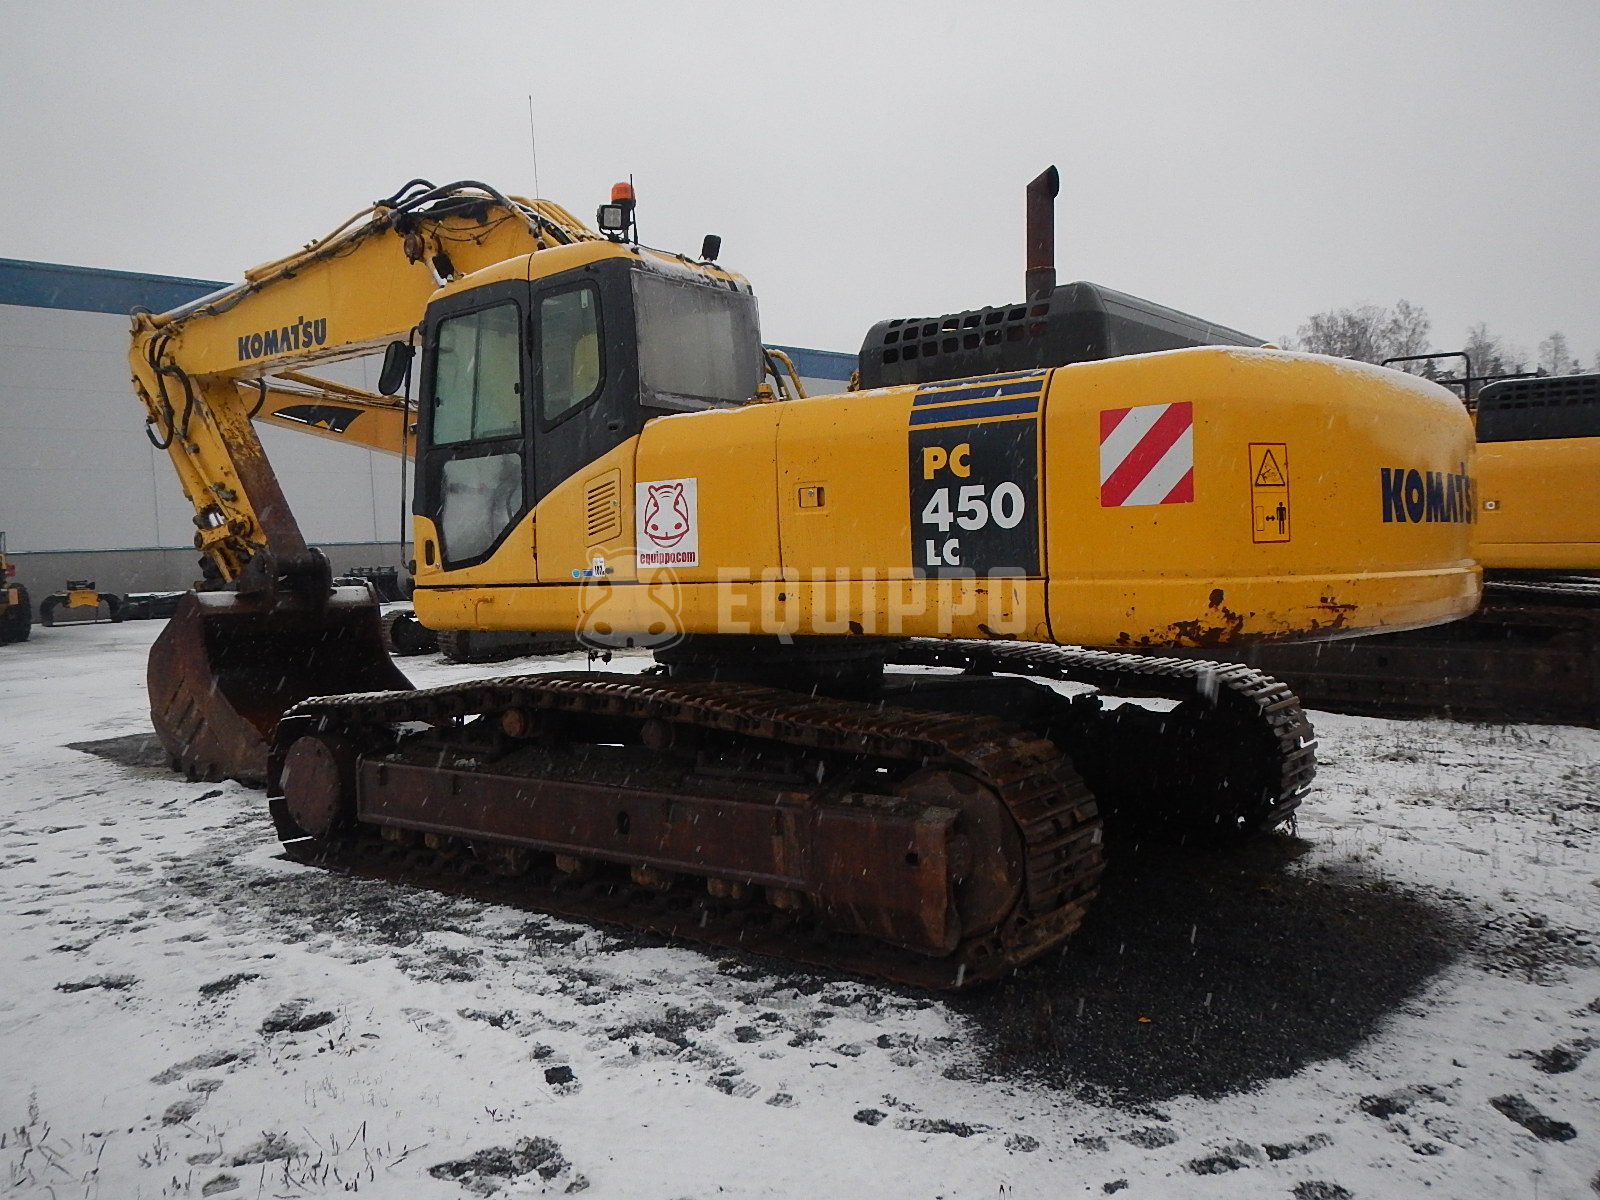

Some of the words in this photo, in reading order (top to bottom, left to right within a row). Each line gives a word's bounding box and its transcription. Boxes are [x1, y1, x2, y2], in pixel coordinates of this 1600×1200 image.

[238, 316, 326, 361] KOMATSU
[923, 443, 971, 479] PC
[922, 481, 1025, 531] 450
[640, 551, 696, 565] equippo.com
[926, 538, 960, 566] LC
